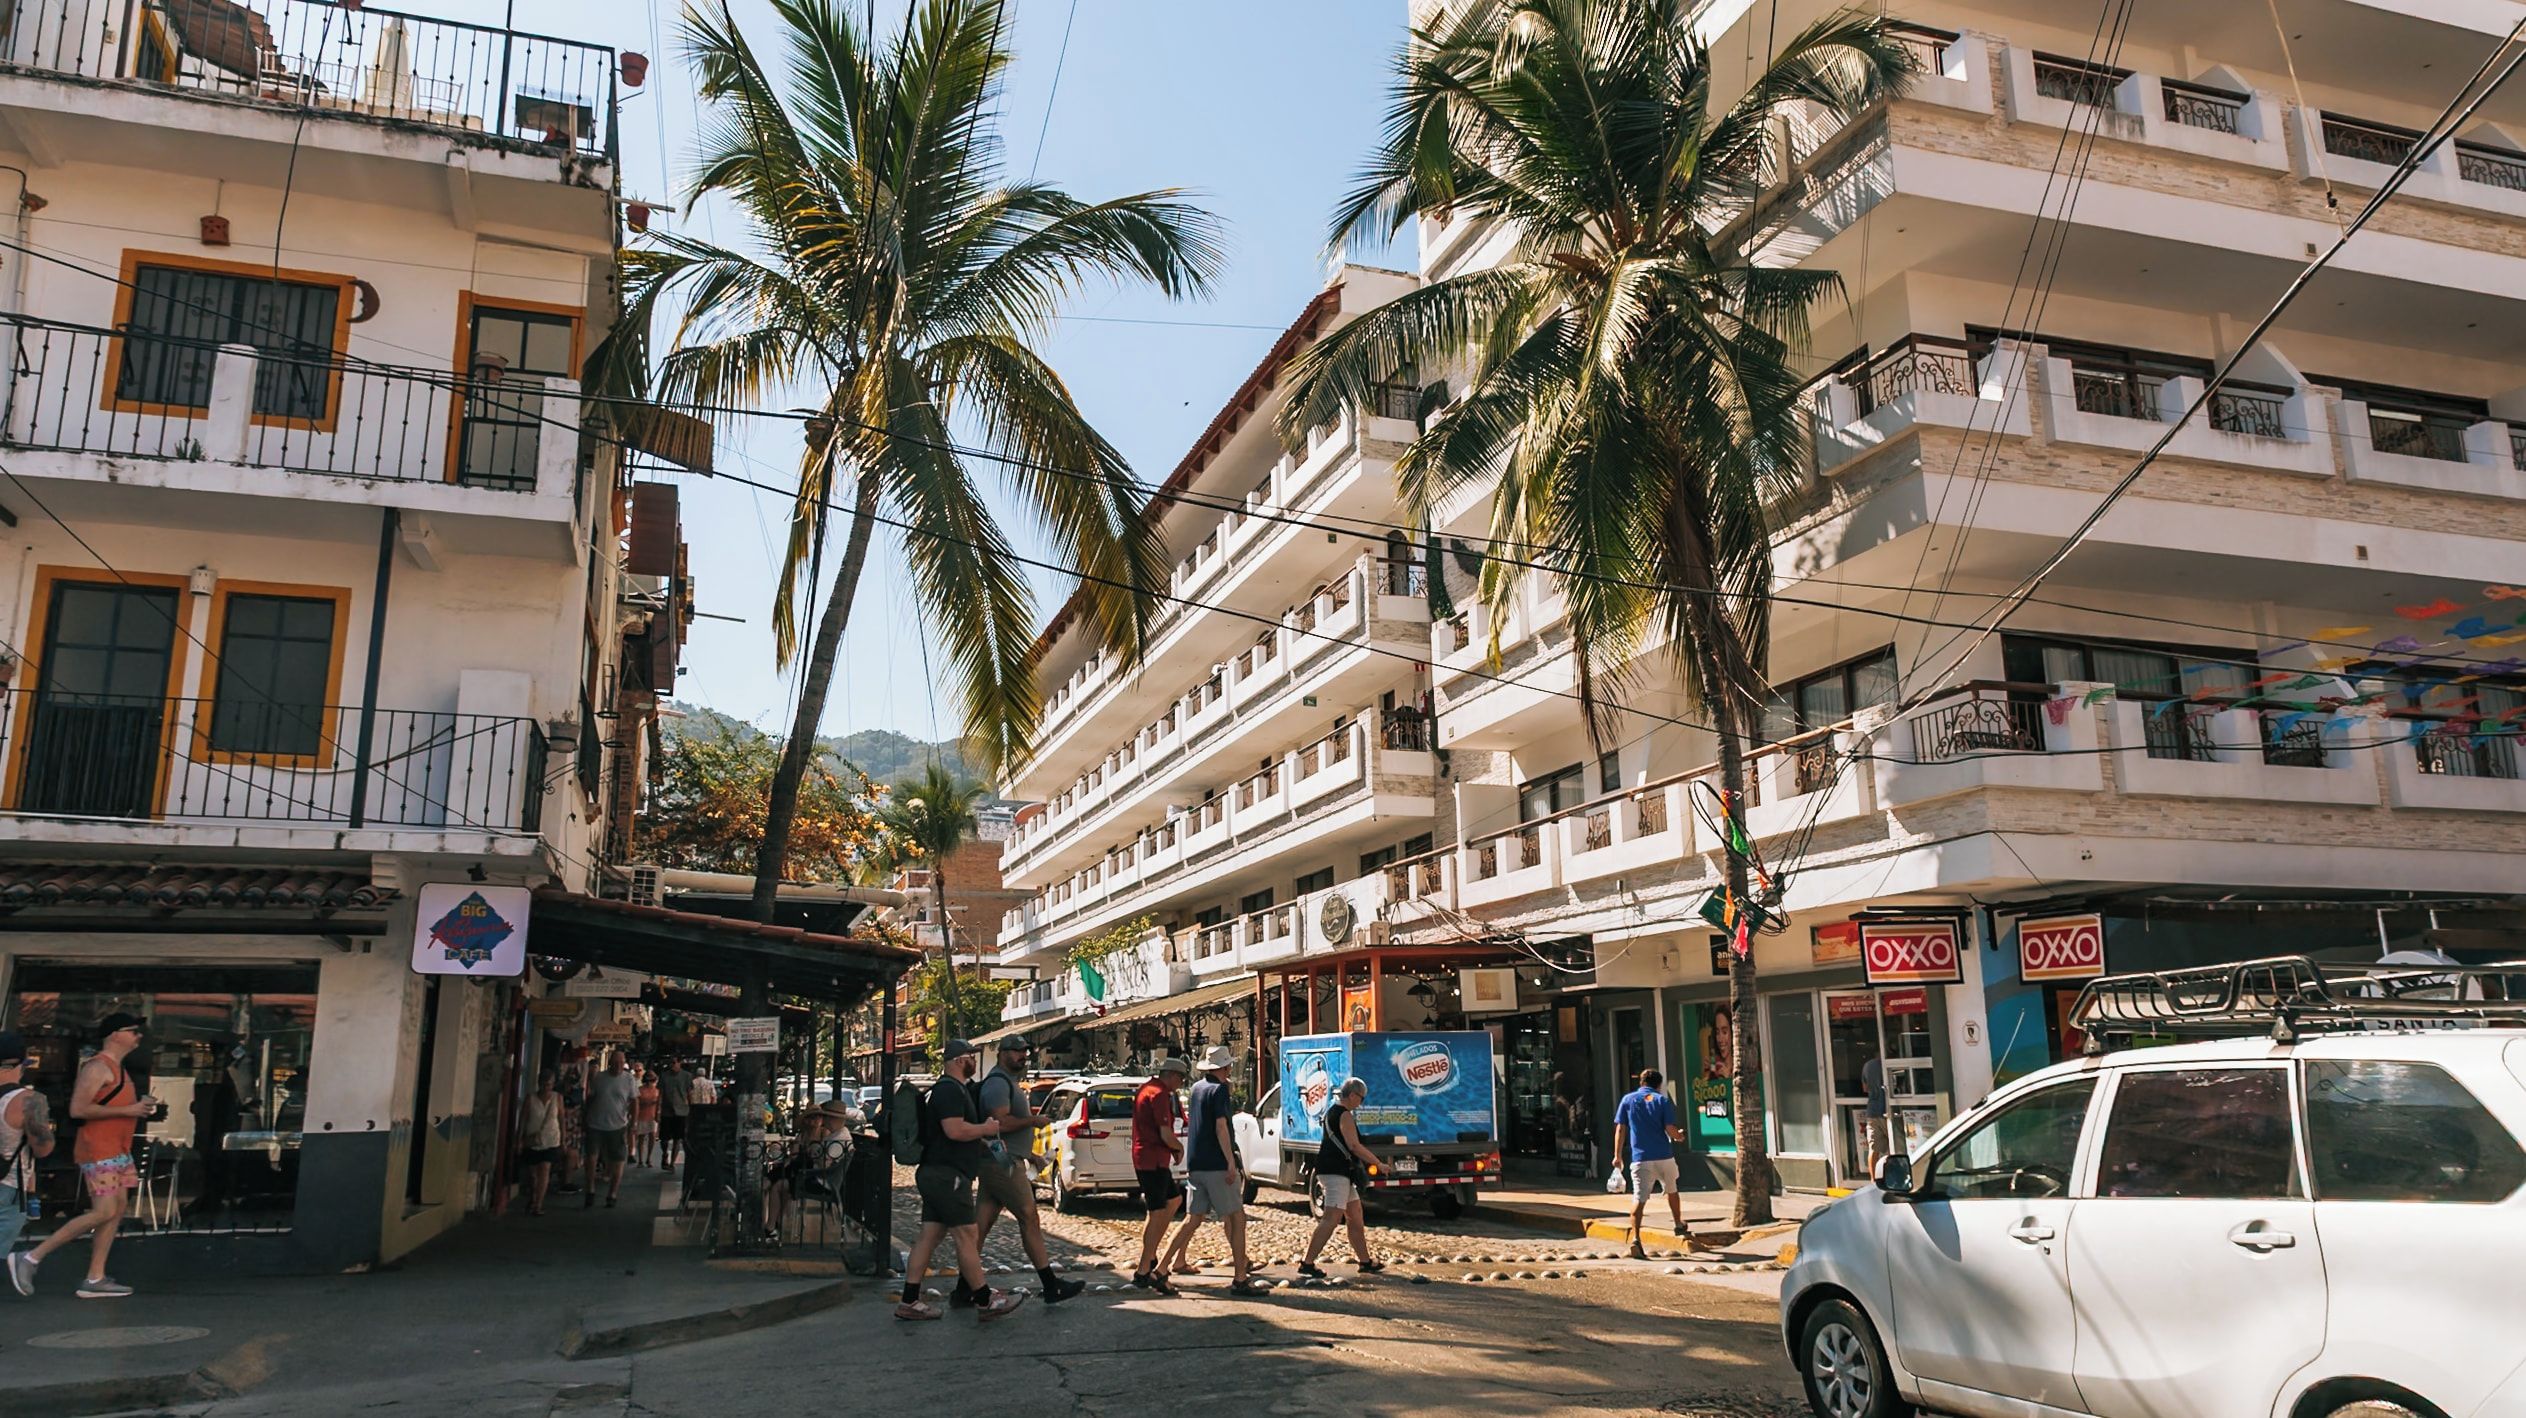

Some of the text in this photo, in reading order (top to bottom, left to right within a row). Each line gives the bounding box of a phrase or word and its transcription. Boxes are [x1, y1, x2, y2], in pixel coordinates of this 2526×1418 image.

[461, 905, 487, 917] BIG
[1870, 934, 1952, 973] OXXO
[2025, 927, 2098, 969] OXXO
[1407, 1044, 1438, 1059] HELADOS
